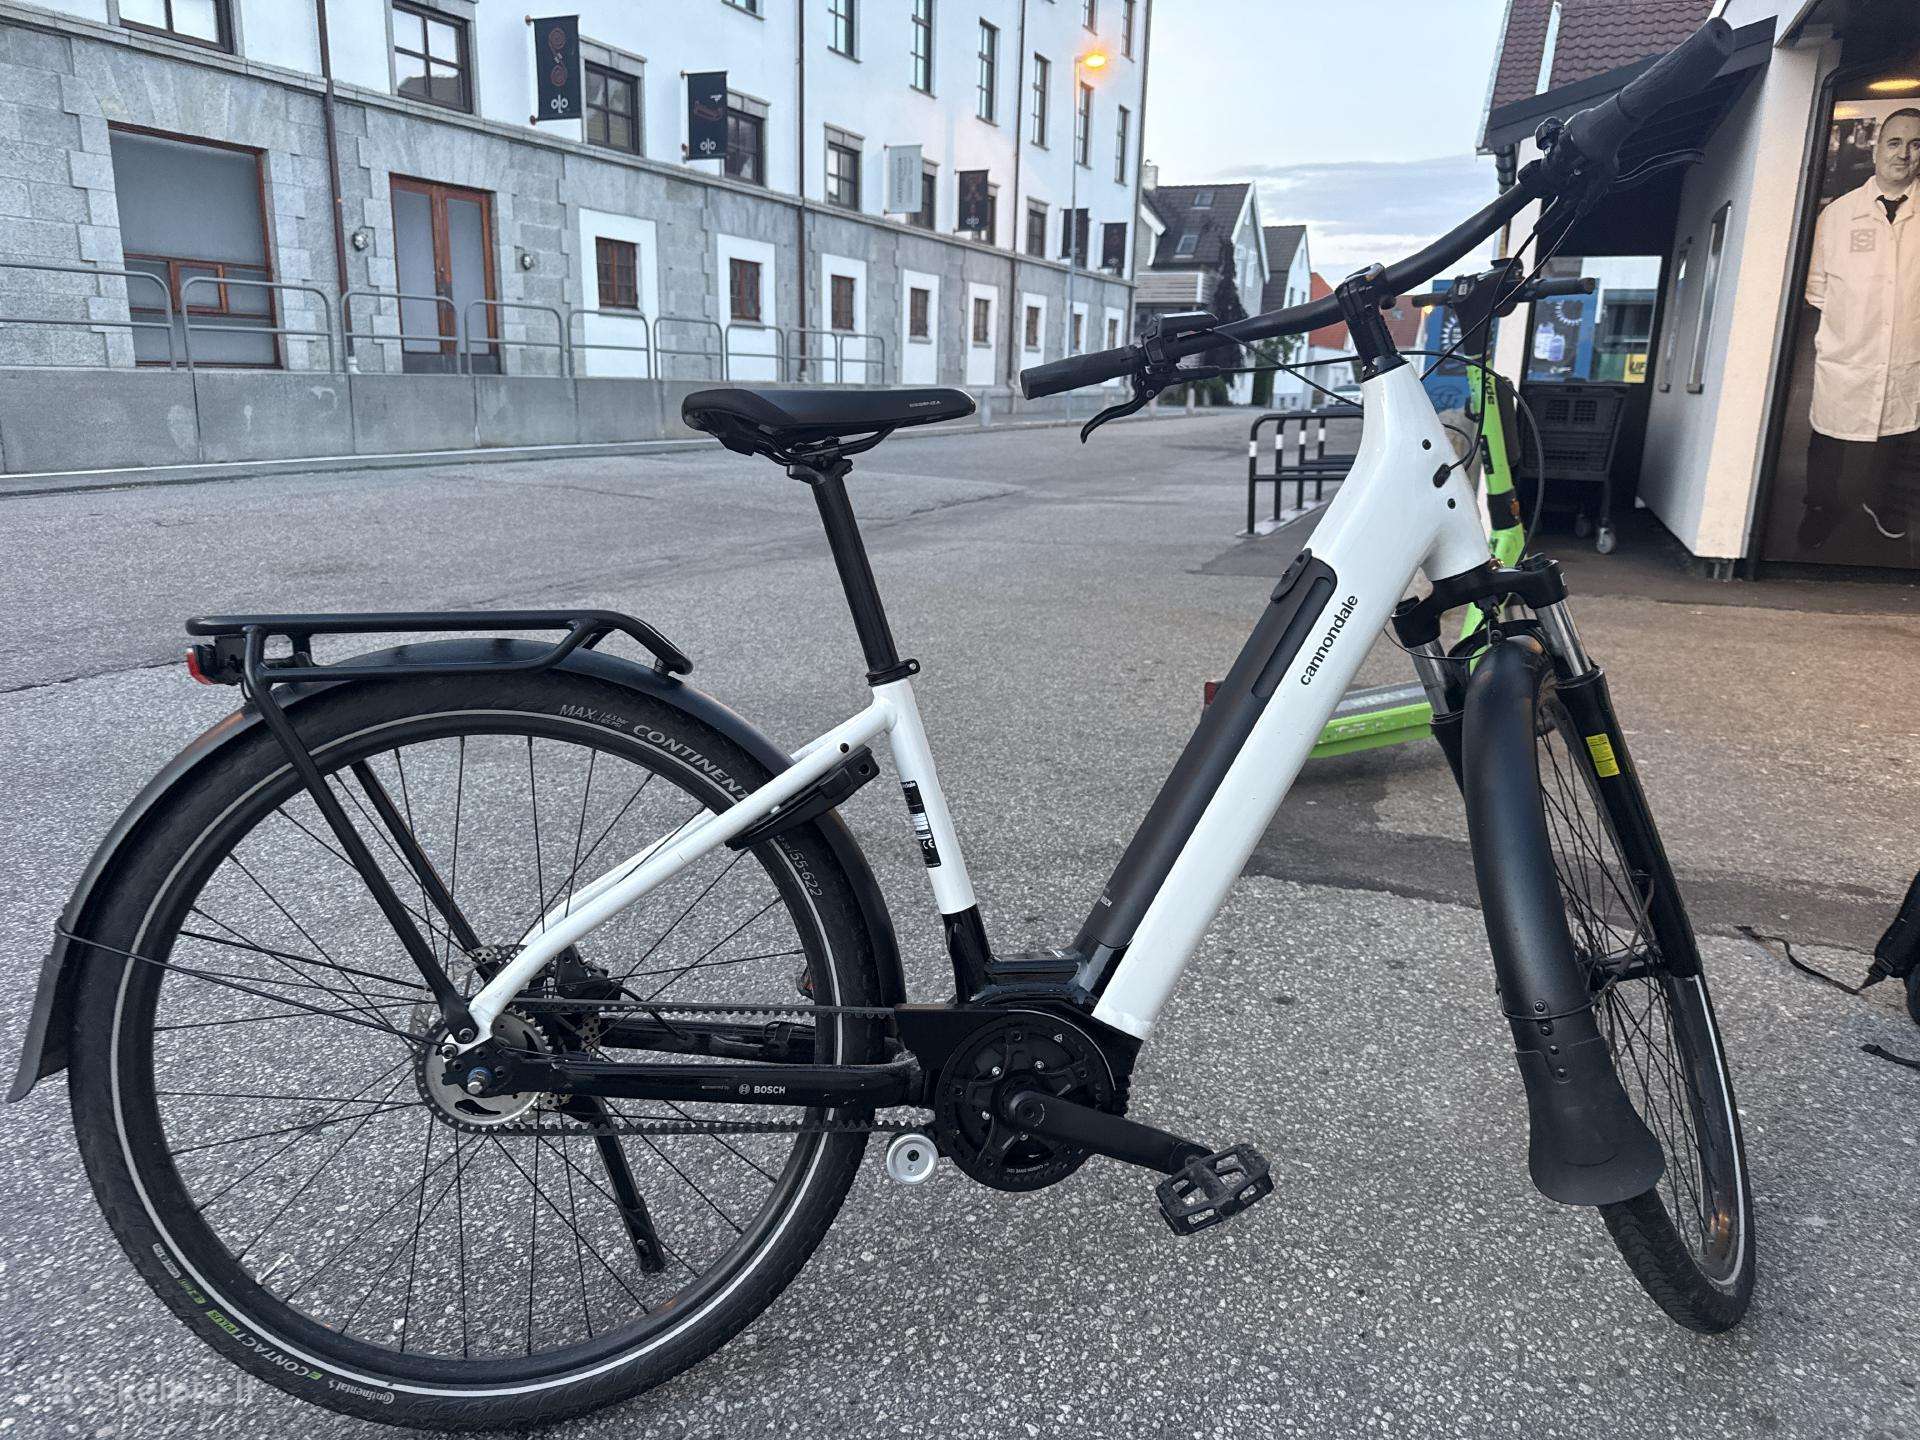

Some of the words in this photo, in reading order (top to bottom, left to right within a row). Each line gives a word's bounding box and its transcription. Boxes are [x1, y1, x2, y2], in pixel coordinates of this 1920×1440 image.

[1300, 595, 1358, 686] cannondale
[789, 850, 823, 896] 55-622
[753, 1085, 786, 1094] BOSCH
[335, 1381, 396, 1405] Continental
